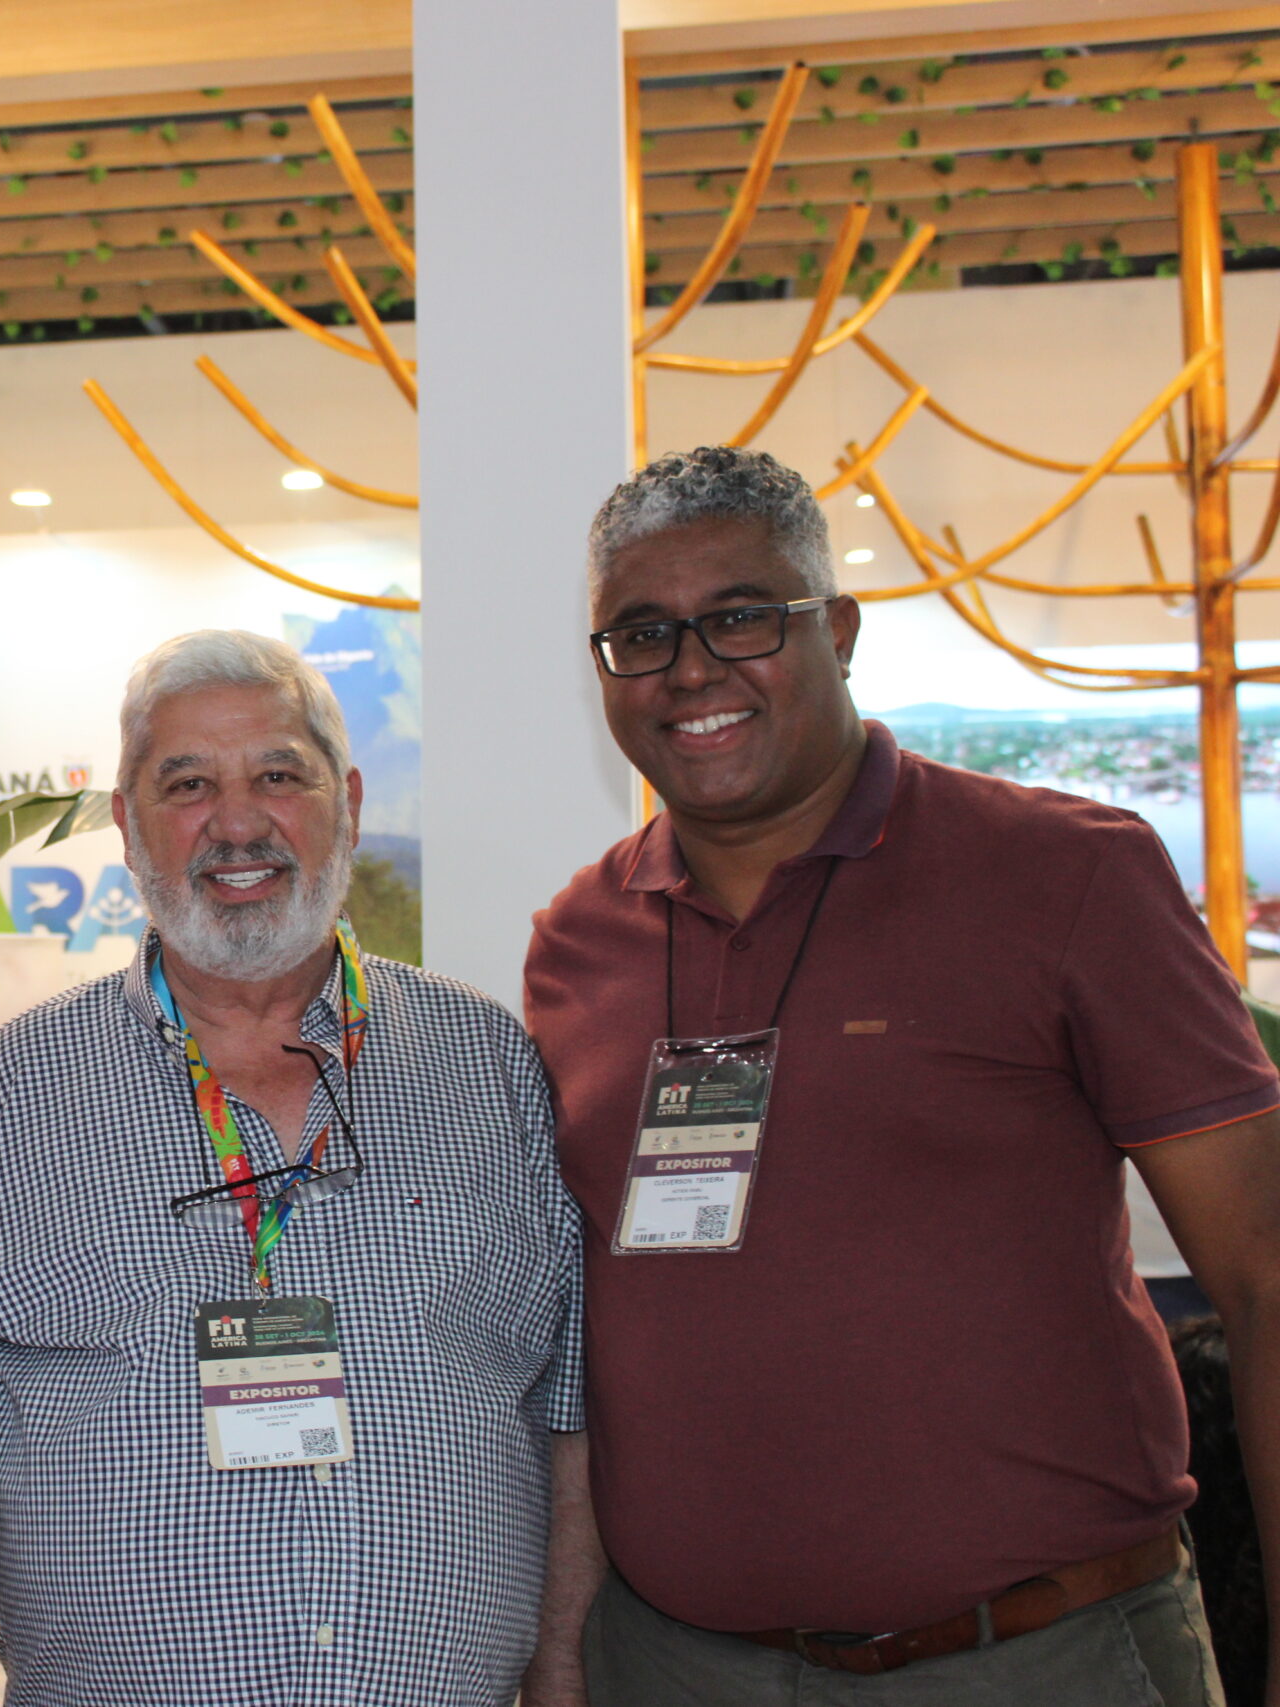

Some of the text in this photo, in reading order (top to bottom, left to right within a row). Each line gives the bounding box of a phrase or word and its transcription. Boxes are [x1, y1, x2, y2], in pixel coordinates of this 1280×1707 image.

[656, 1157, 732, 1171] EXPOSITOR
[670, 1231, 687, 1239] EXP
[211, 1341, 248, 1349] LATINA
[229, 1385, 320, 1400] EXPOSITOR
[269, 1402, 316, 1411] FERNANDES
[275, 1451, 295, 1460] EXP
